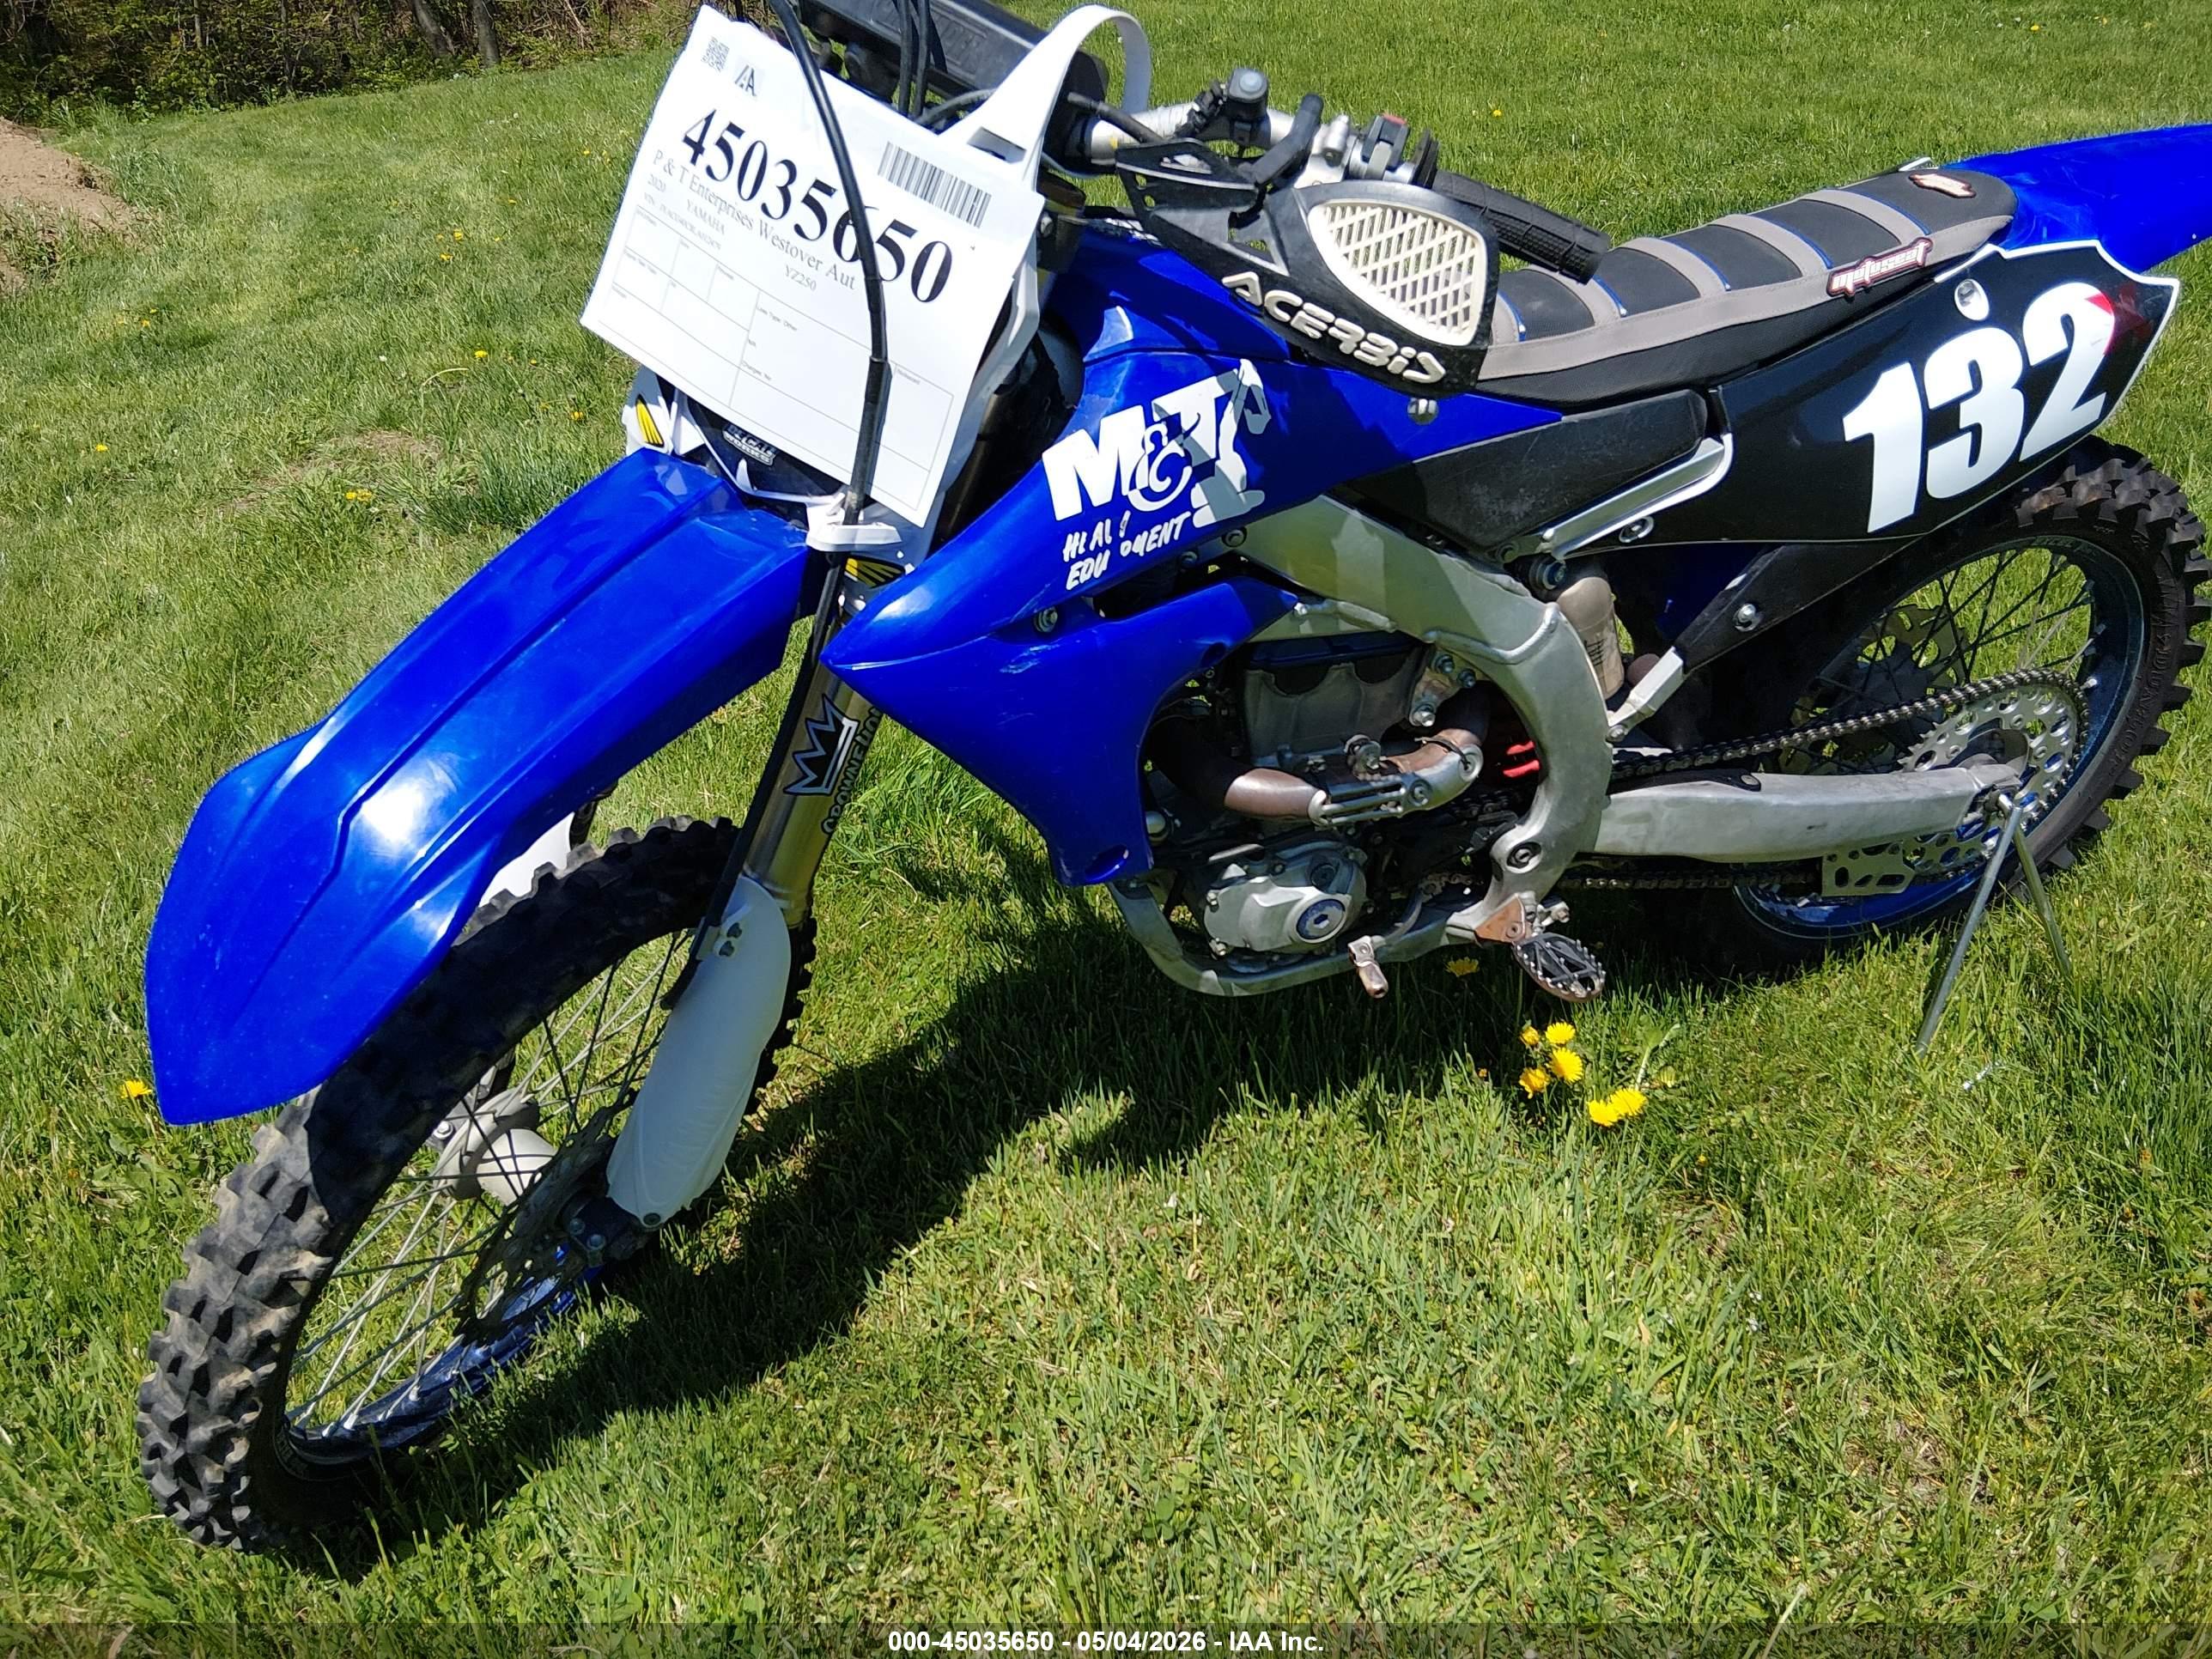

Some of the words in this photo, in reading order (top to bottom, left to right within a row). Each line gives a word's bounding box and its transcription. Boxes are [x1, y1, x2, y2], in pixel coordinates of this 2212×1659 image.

[653, 149, 663, 165] P
[663, 157, 675, 176] &
[679, 165, 689, 184] T
[690, 173, 753, 230] Enterprises
[760, 219, 823, 270] Westover
[825, 264, 856, 290] Aut
[682, 108, 953, 303] 45035650
[687, 199, 726, 234] YAMAHA
[785, 264, 817, 291] YZ250
[1221, 271, 1446, 384] ACERBIS
[1843, 281, 2116, 533] 132
